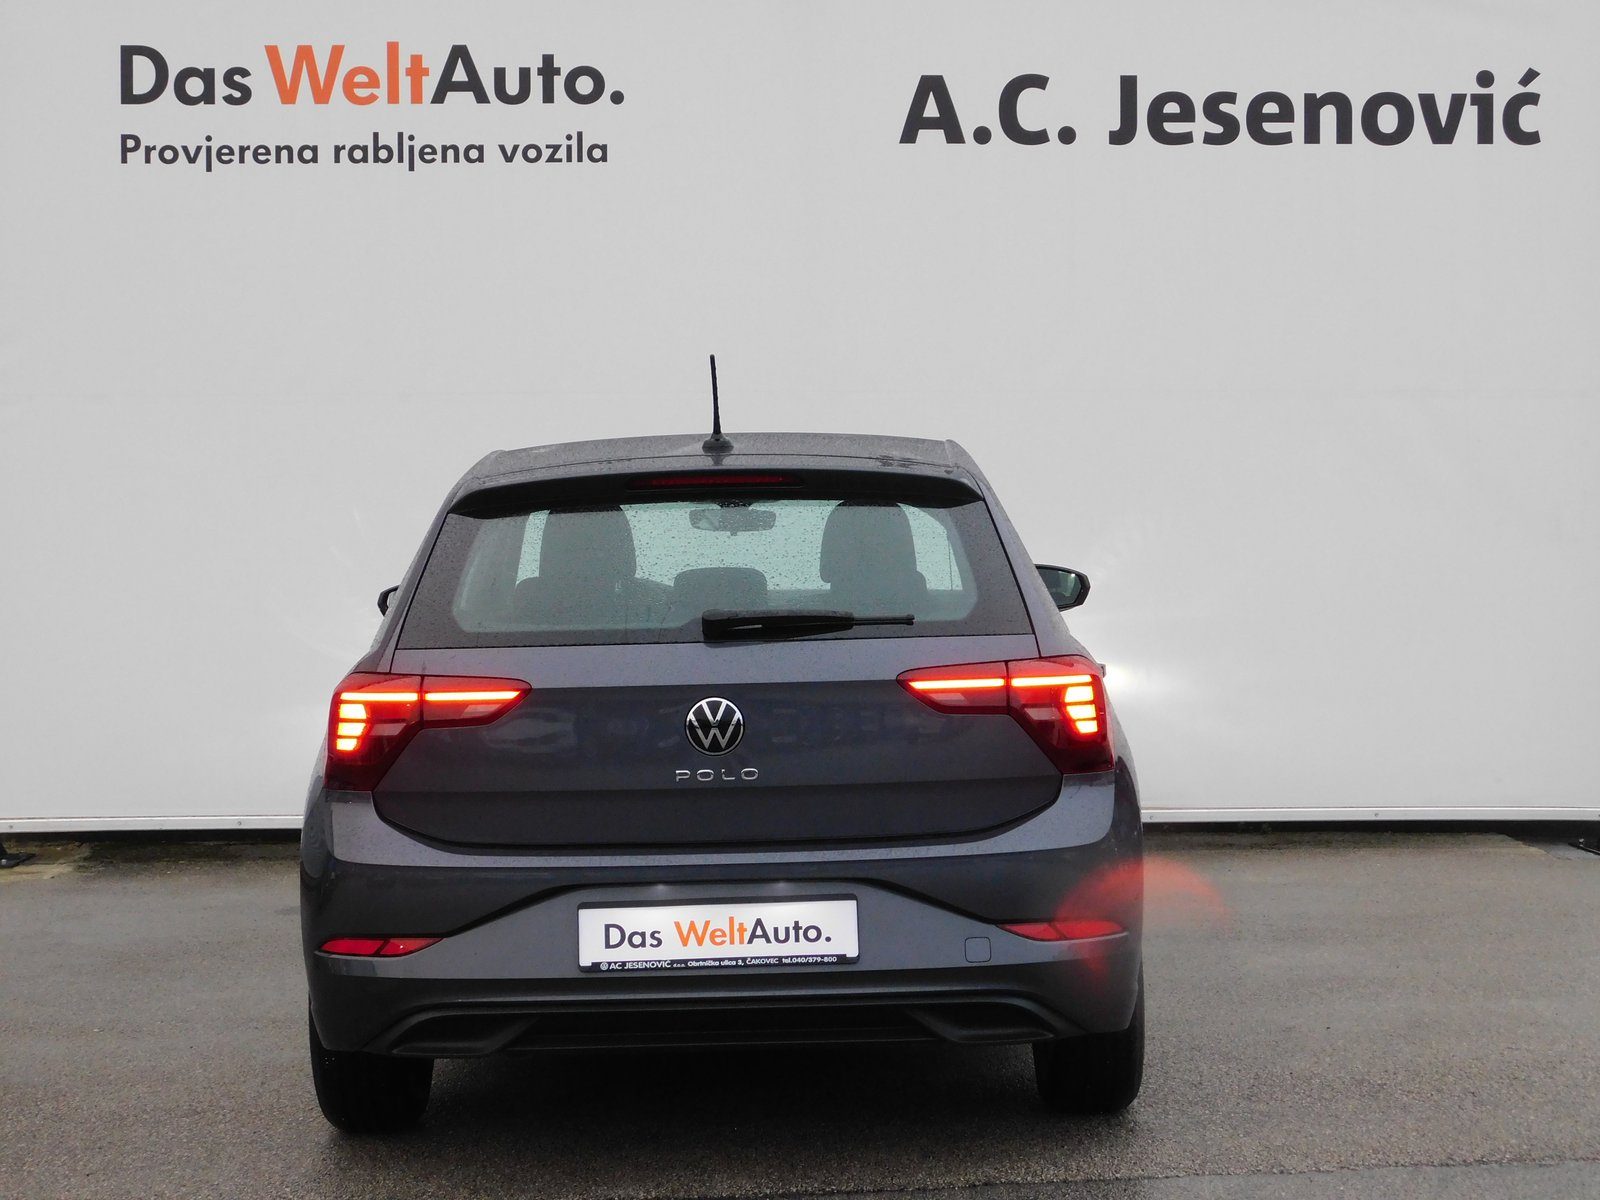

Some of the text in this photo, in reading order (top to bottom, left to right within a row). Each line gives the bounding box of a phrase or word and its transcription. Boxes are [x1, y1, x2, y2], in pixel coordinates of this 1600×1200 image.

[120, 41, 625, 107] Das WeltAuto.
[898, 67, 1542, 147] A.C. Jesenović
[120, 130, 608, 173] Provjerena rabljena vozila
[675, 767, 759, 782] POLO
[603, 916, 832, 950] Das WeltAuto.
[609, 961, 622, 970] AC
[623, 959, 671, 970] JESENOVIĆ
[746, 957, 779, 966] ČAKOVEC
